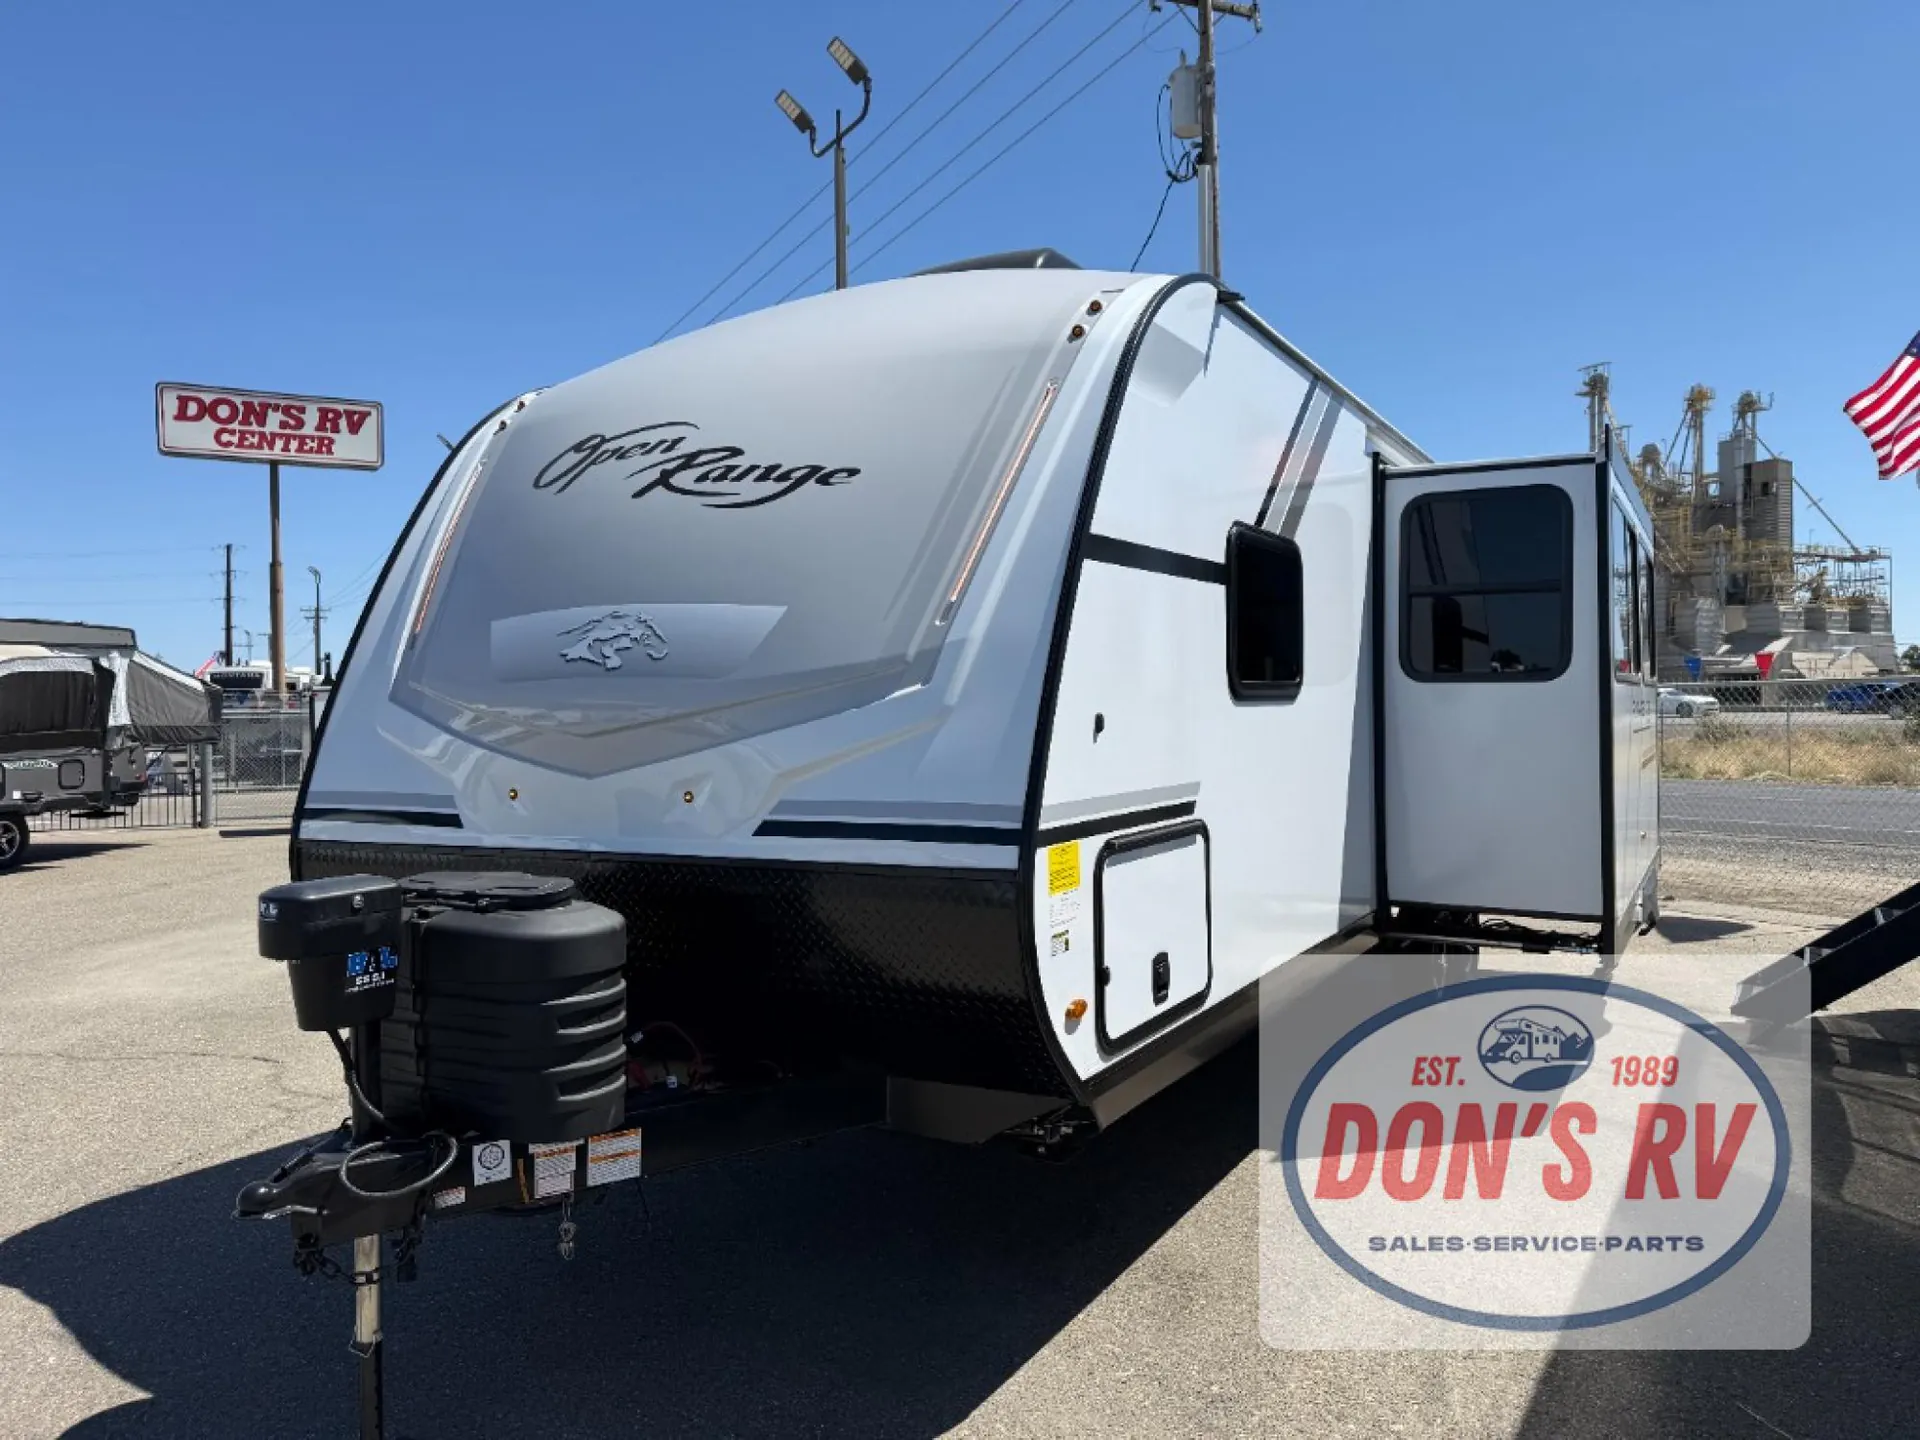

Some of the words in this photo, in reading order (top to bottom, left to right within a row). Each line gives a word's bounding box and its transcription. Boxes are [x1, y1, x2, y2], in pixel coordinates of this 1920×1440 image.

[173, 394, 306, 431] DON'S
[315, 407, 372, 435] RV
[213, 427, 335, 456] CENTER
[533, 422, 699, 494] Open
[624, 446, 861, 508] Range
